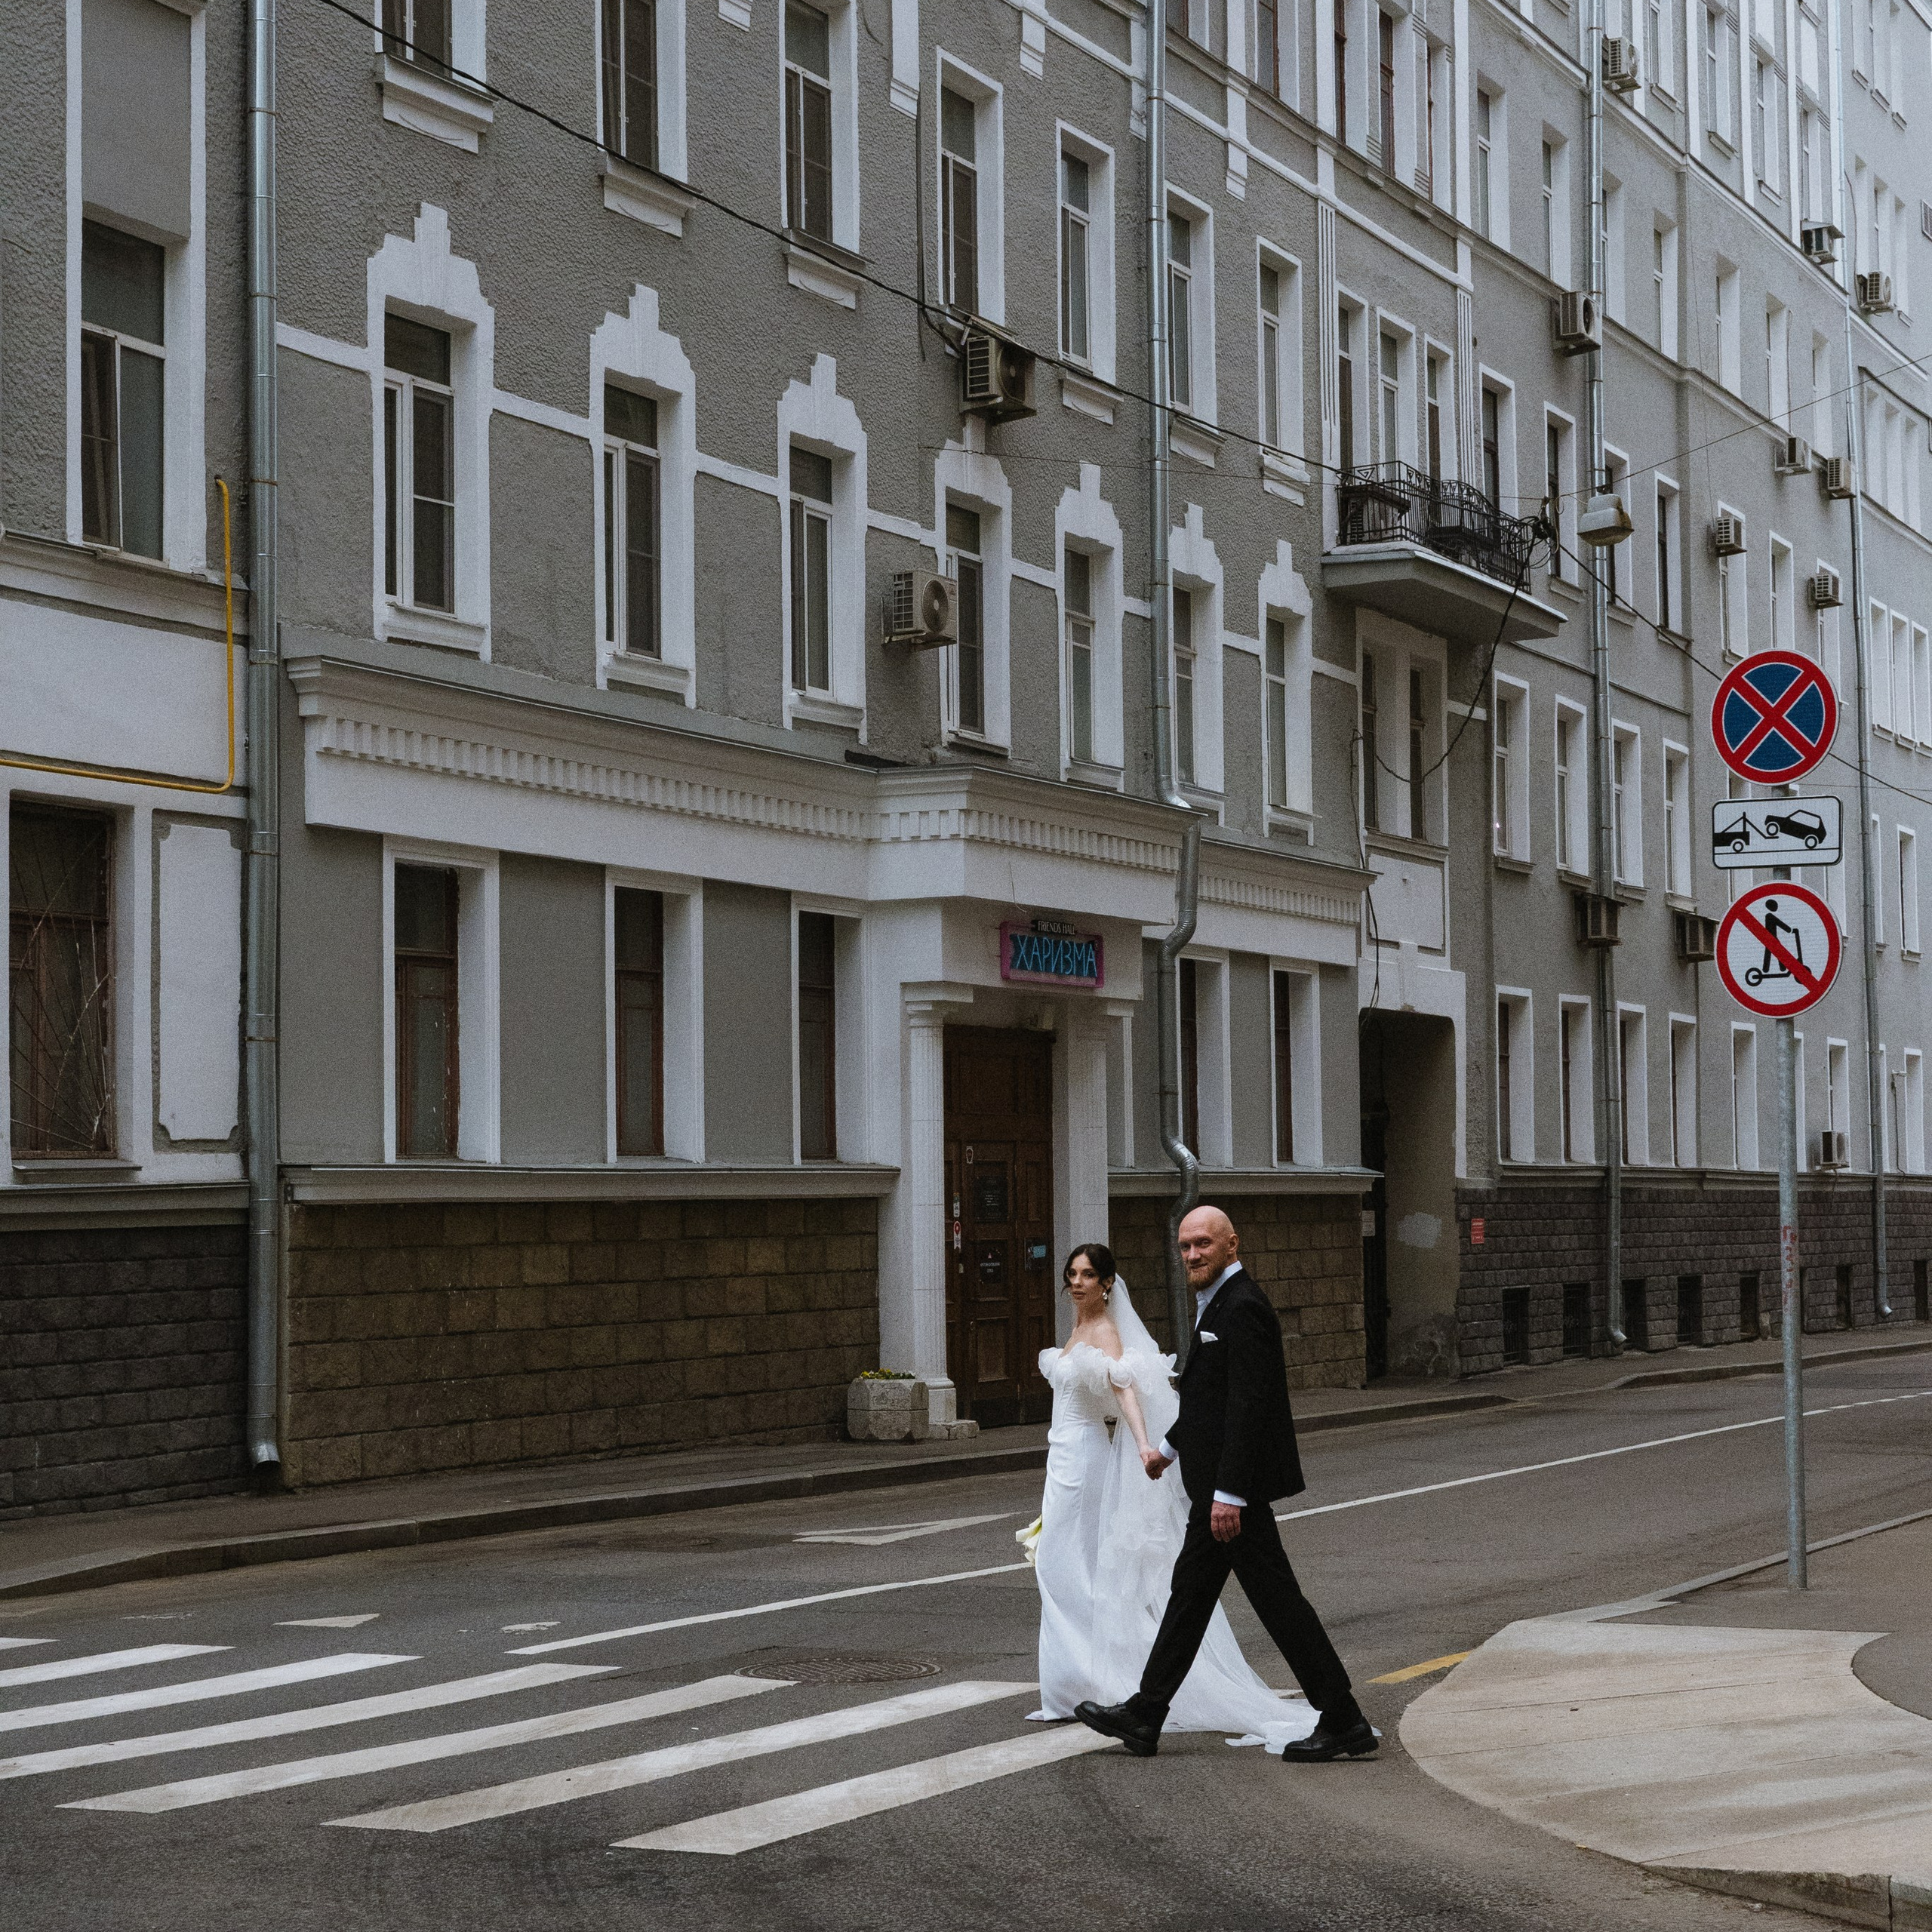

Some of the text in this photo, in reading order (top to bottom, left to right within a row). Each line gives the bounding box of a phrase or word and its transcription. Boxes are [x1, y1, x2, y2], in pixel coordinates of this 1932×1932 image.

[1038, 920, 1075, 935] FRIENDS HALL
[1016, 934, 1098, 977] ХАРИЗМА
